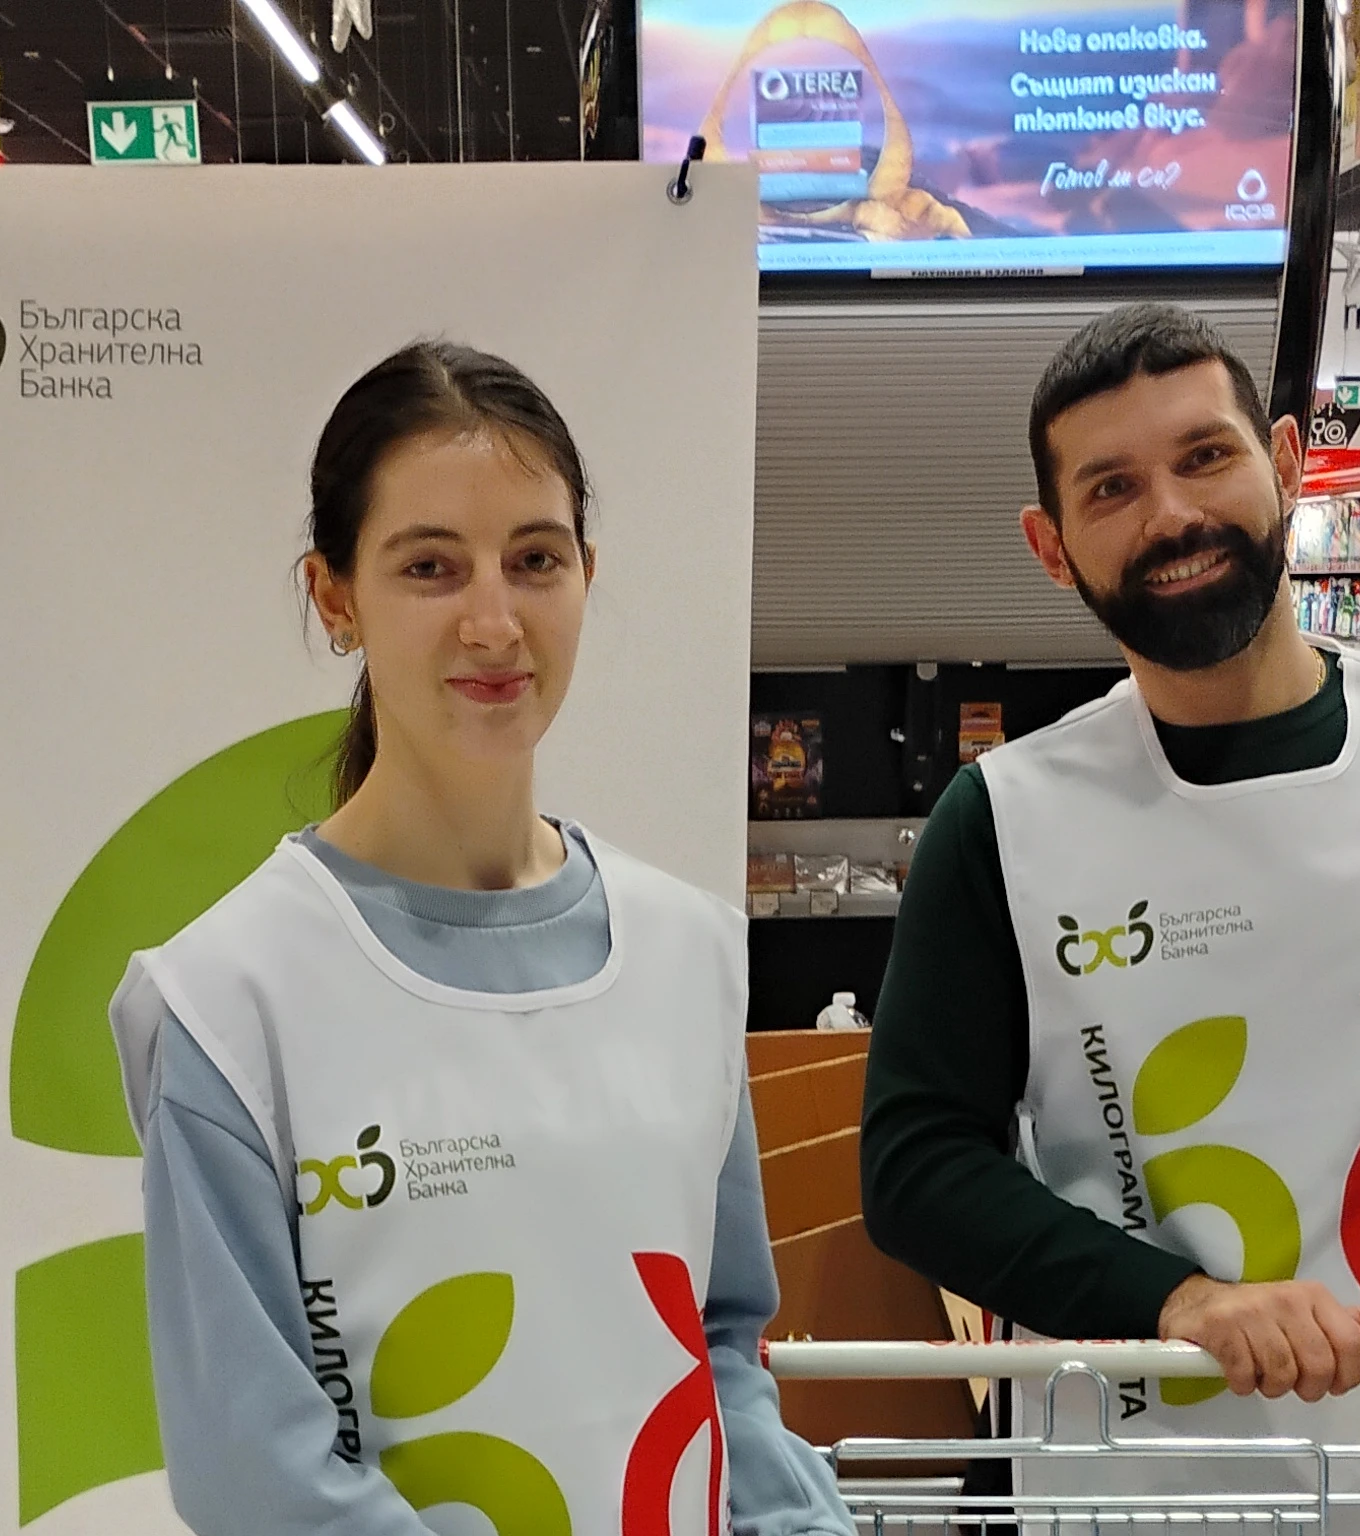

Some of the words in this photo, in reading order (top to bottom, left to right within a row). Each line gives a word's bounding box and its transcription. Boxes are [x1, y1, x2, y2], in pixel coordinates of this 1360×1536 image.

[1019, 26, 1082, 54] Нова
[1086, 23, 1208, 51] опаковка.
[792, 71, 858, 95] TEREA
[1010, 72, 1114, 100] Същият
[1119, 66, 1217, 100] изискан
[1014, 103, 1139, 132] тютюнев
[1144, 102, 1207, 135] вкус.
[1040, 158, 1109, 197] Готов
[1224, 203, 1276, 221] IQOS
[19, 300, 183, 335] Българска
[19, 336, 204, 368] Хранителна
[19, 369, 113, 400] Банка
[1158, 904, 1242, 928] Българска
[1159, 918, 1254, 945] Хранителна
[1160, 941, 1209, 961] Банка
[1079, 1023, 1148, 1233] КИЛОГРАМ
[398, 1130, 502, 1158] Българска
[403, 1152, 516, 1181] Хранителна
[407, 1177, 468, 1200] Банка
[299, 1278, 364, 1465] КИЛОГР
